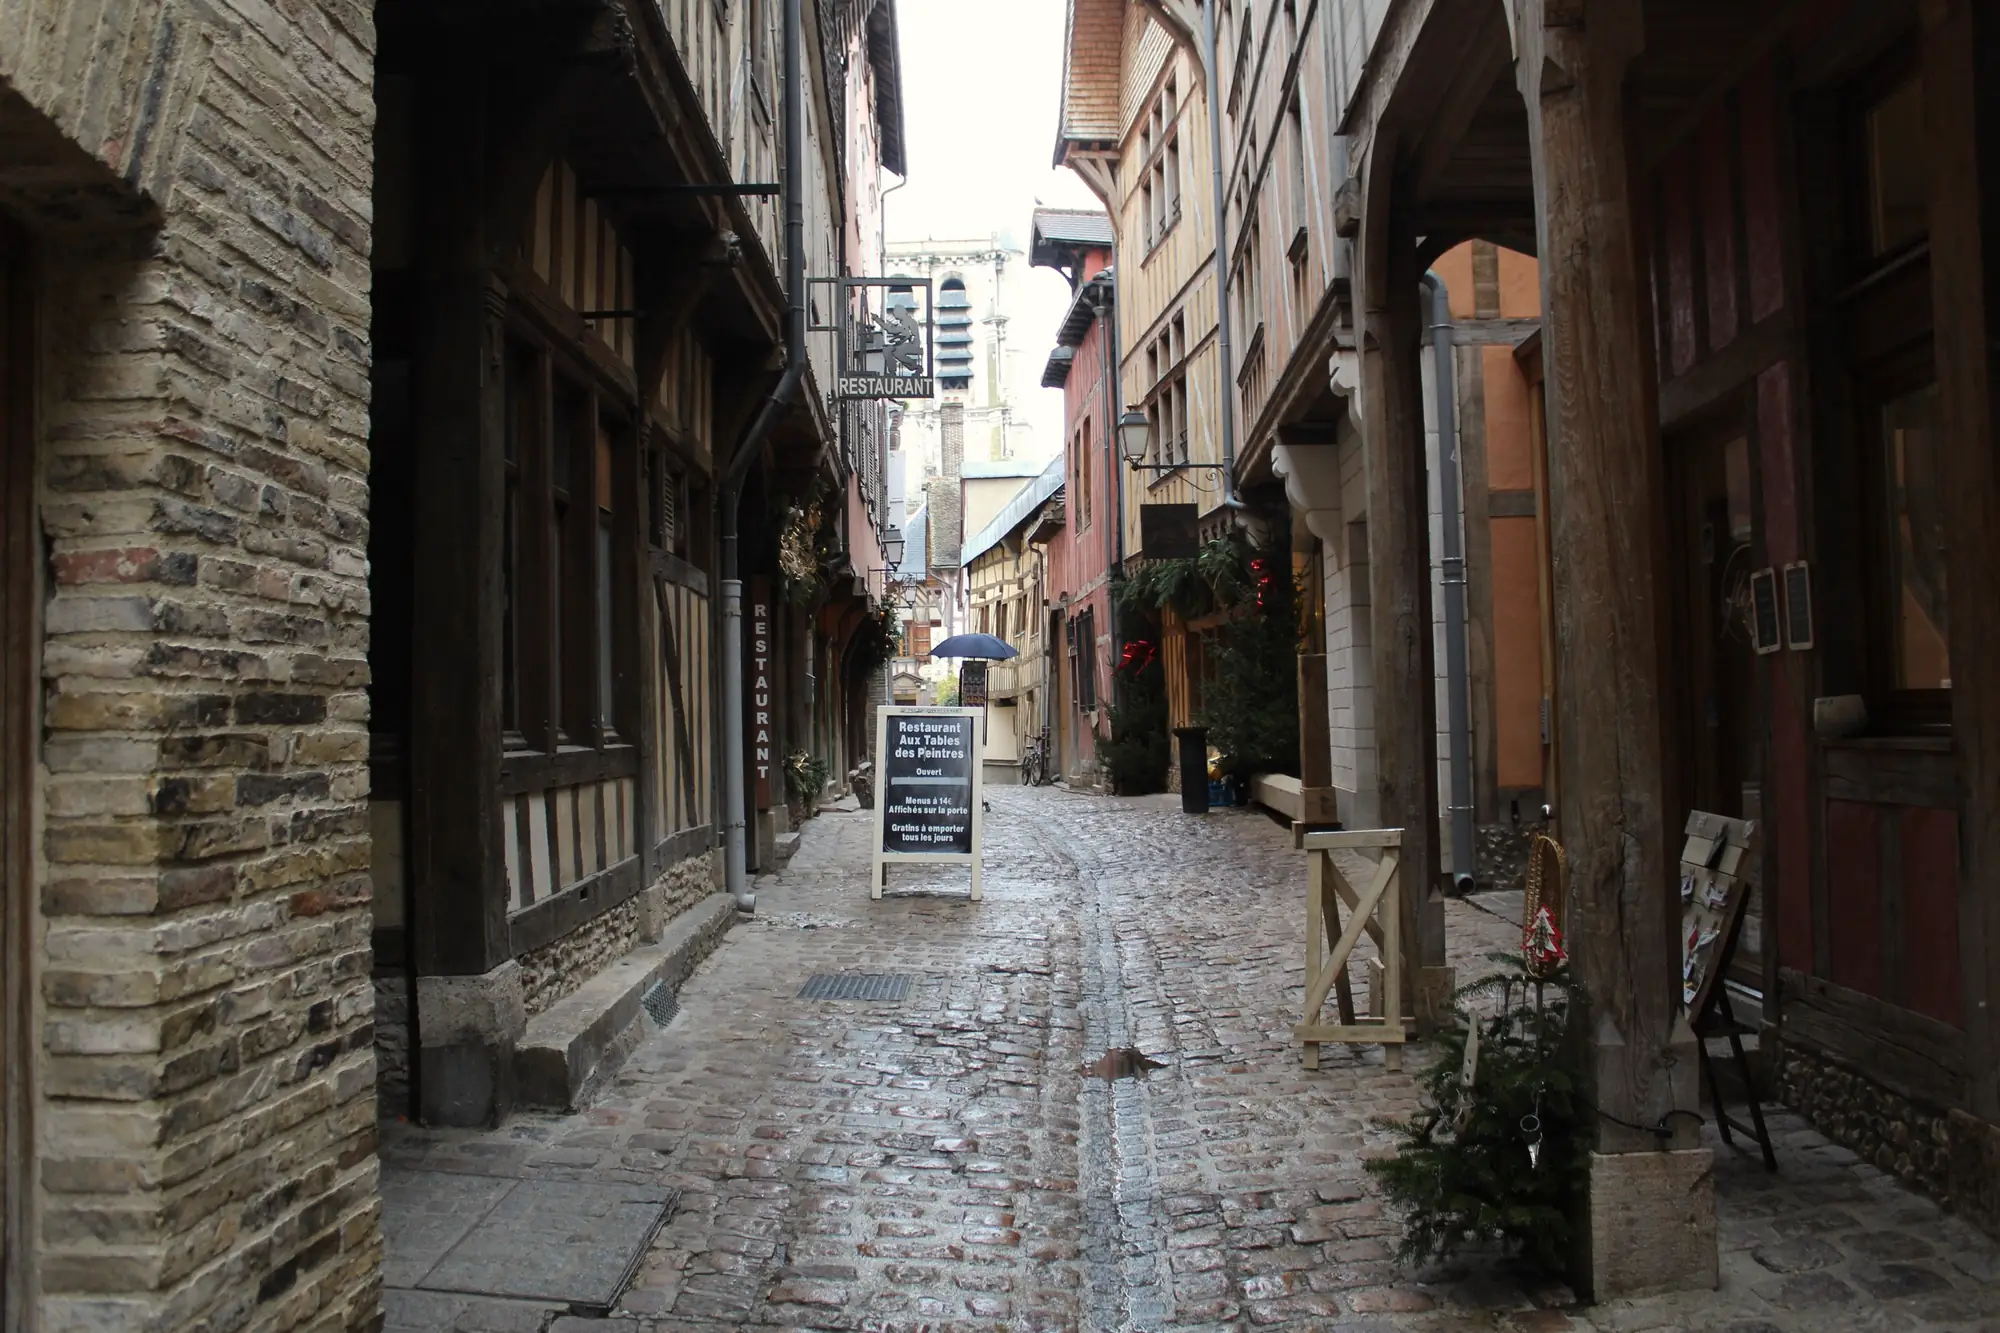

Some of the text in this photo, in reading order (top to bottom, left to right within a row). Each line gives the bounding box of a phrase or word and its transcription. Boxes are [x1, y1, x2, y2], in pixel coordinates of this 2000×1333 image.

[840, 378, 932, 396] RESTAURANT
[754, 604, 769, 779] RESTAURANT
[899, 721, 961, 733] Restaurant
[900, 735, 960, 746] Aux Tables
[895, 748, 964, 759] des Peintres
[916, 768, 942, 776] Ouvert
[905, 796, 953, 805] Menus à 14€
[888, 805, 922, 814] Affichés
[938, 806, 946, 814] la
[946, 807, 968, 816] porte
[891, 824, 964, 834] Gratins à emporter
[902, 833, 954, 843] tous les jours
